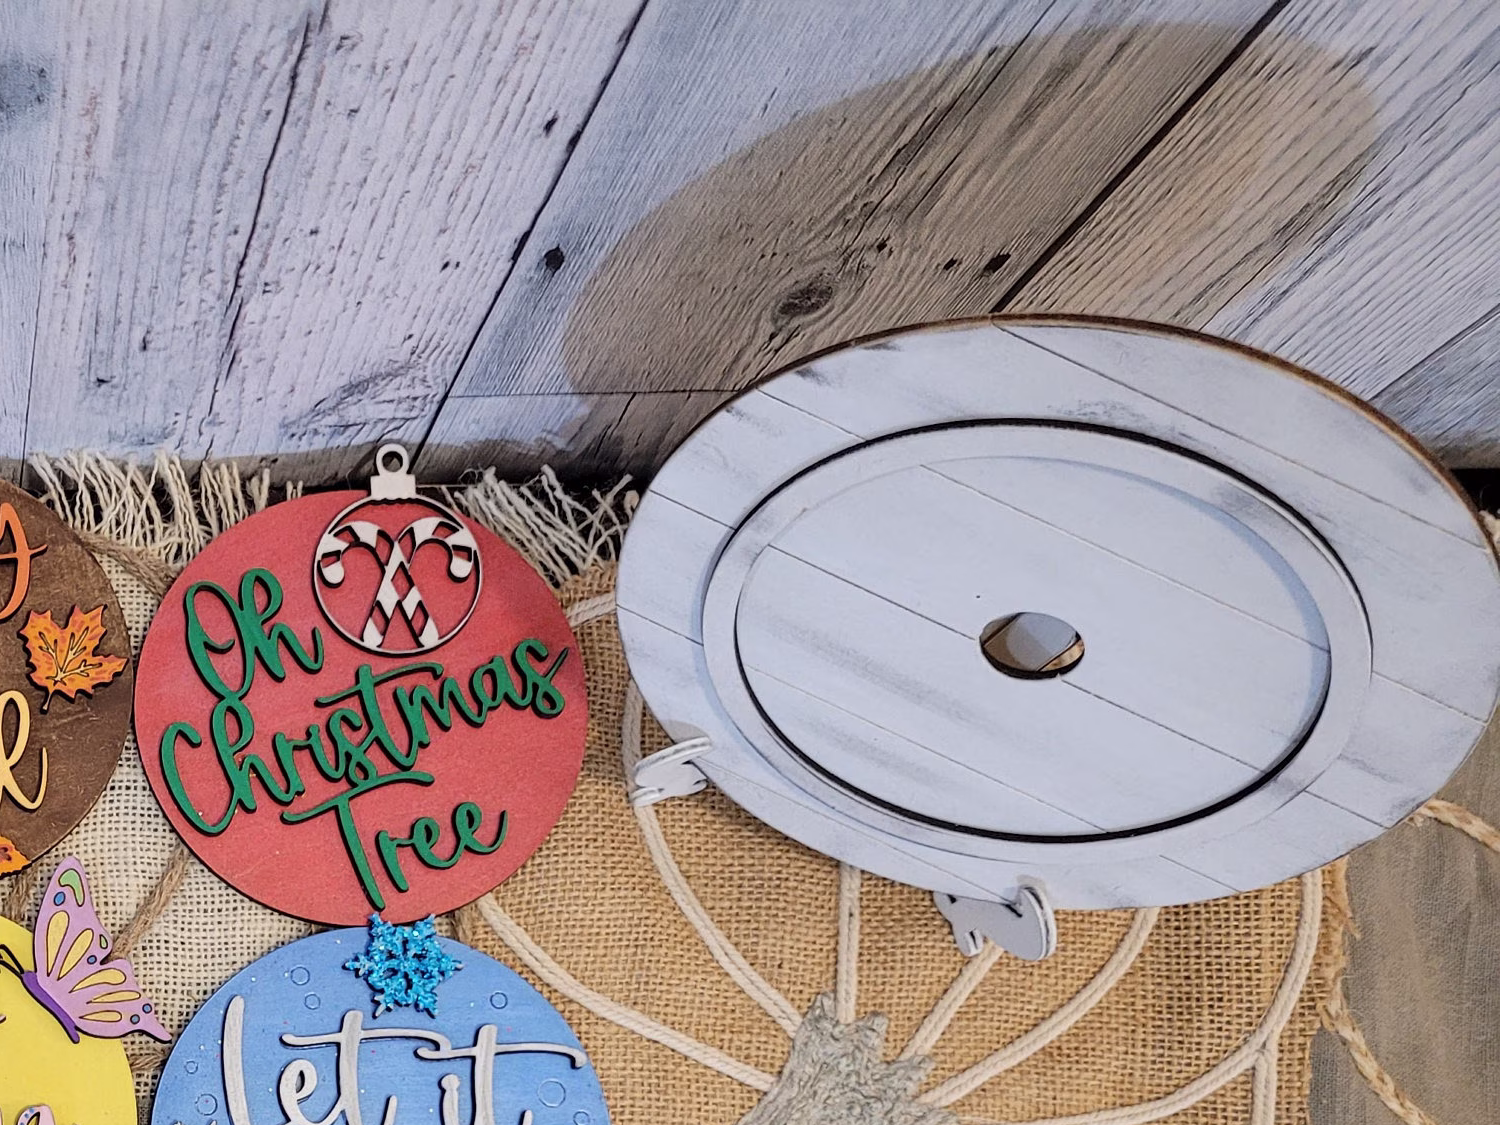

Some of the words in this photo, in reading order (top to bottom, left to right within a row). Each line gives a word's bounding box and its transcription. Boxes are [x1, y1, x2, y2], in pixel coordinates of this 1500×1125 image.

[184, 568, 324, 700] Oh
[159, 638, 570, 836] Christmas
[280, 770, 508, 911] Tree
